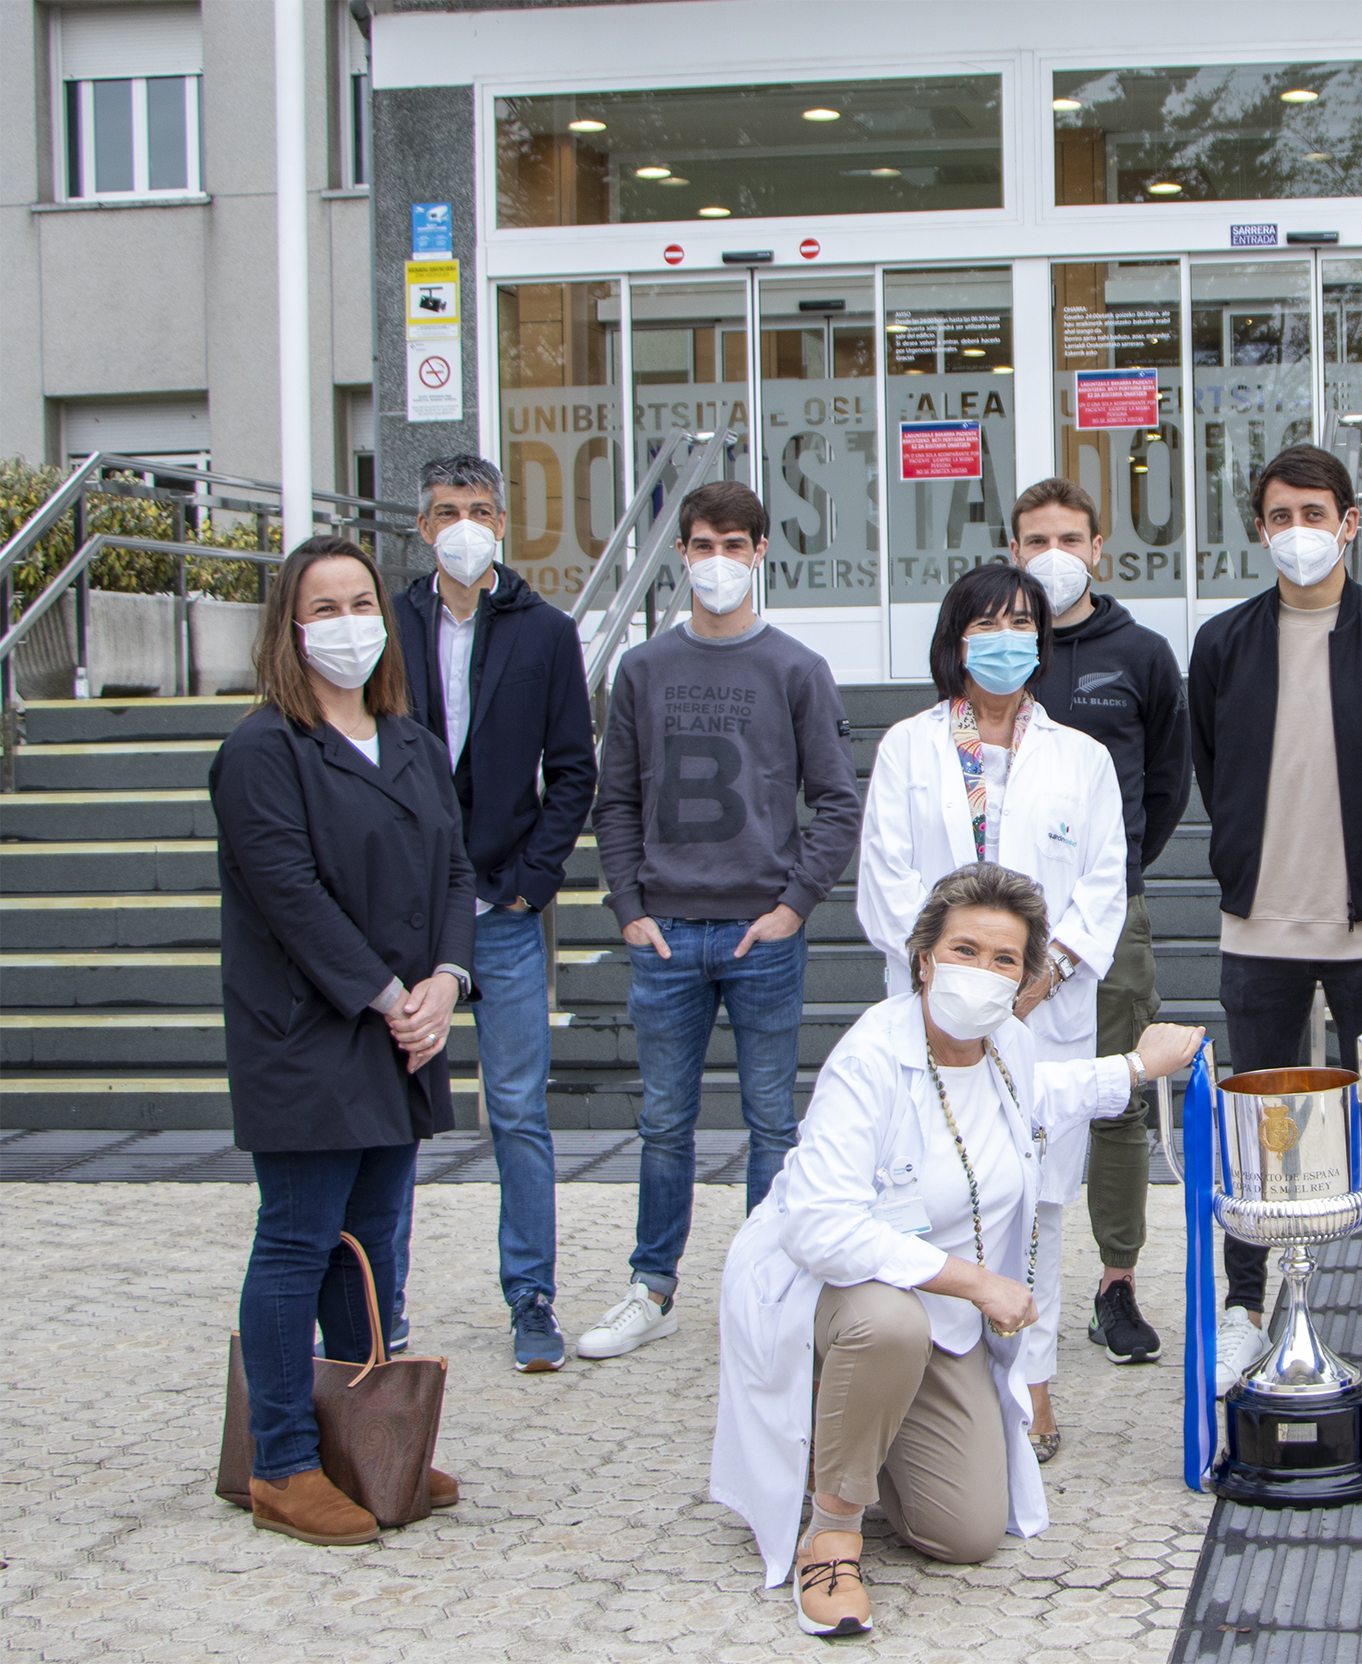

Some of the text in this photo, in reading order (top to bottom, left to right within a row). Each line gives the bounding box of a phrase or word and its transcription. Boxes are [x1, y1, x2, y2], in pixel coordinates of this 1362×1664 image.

[1232, 225, 1276, 236] SARRERA
[1233, 235, 1276, 246] ENTRADA
[508, 389, 1007, 435] UNIBERTSITAE OSPALEA
[509, 424, 1010, 562] DOSTIA
[1094, 550, 1259, 583] OSPITAL
[664, 685, 757, 704] BECAUSE
[1090, 697, 1128, 708] BLACKS
[666, 702, 752, 717] THERE IS NO
[664, 715, 752, 735] PLANET
[656, 734, 748, 844] B
[1230, 1167, 1341, 1182] AMPEONATO DE ESPAÑA
[1310, 1181, 1333, 1192] REY
